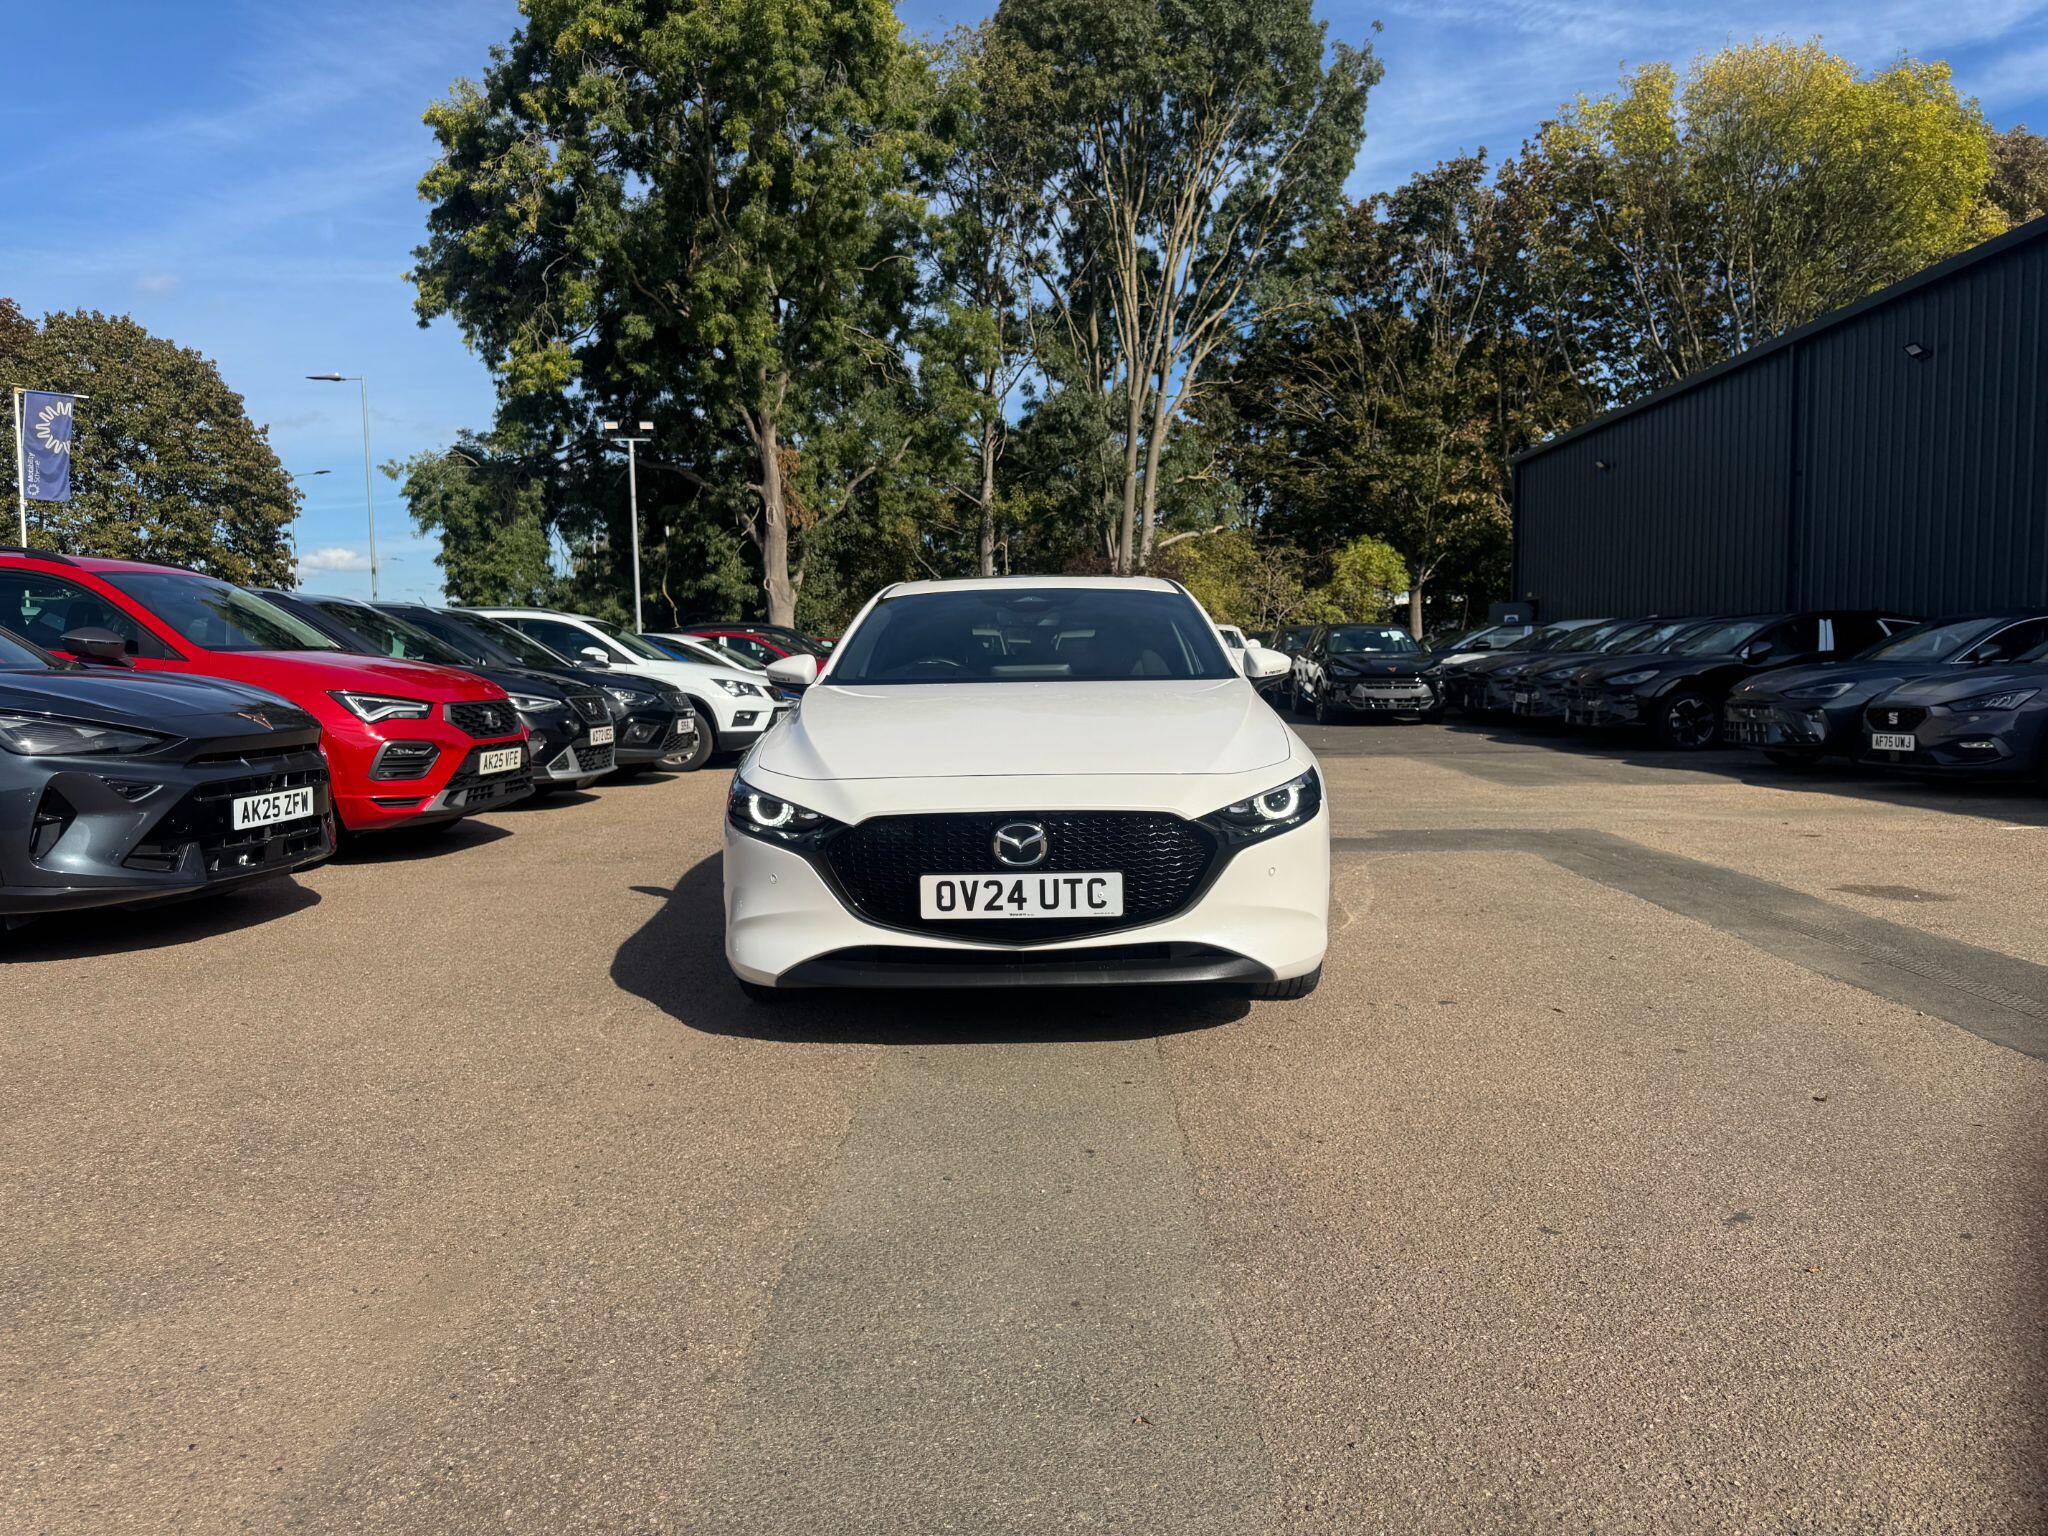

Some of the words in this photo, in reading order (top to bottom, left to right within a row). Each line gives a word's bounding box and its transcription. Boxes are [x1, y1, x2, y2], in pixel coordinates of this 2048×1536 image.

[1875, 735, 1893, 747] AF75
[483, 752, 503, 771] AK25
[505, 750, 519, 767] VFE
[242, 797, 280, 823] AK25
[284, 791, 308, 815] ZFW
[936, 879, 1028, 912] OV24
[1039, 878, 1107, 910] UTC
